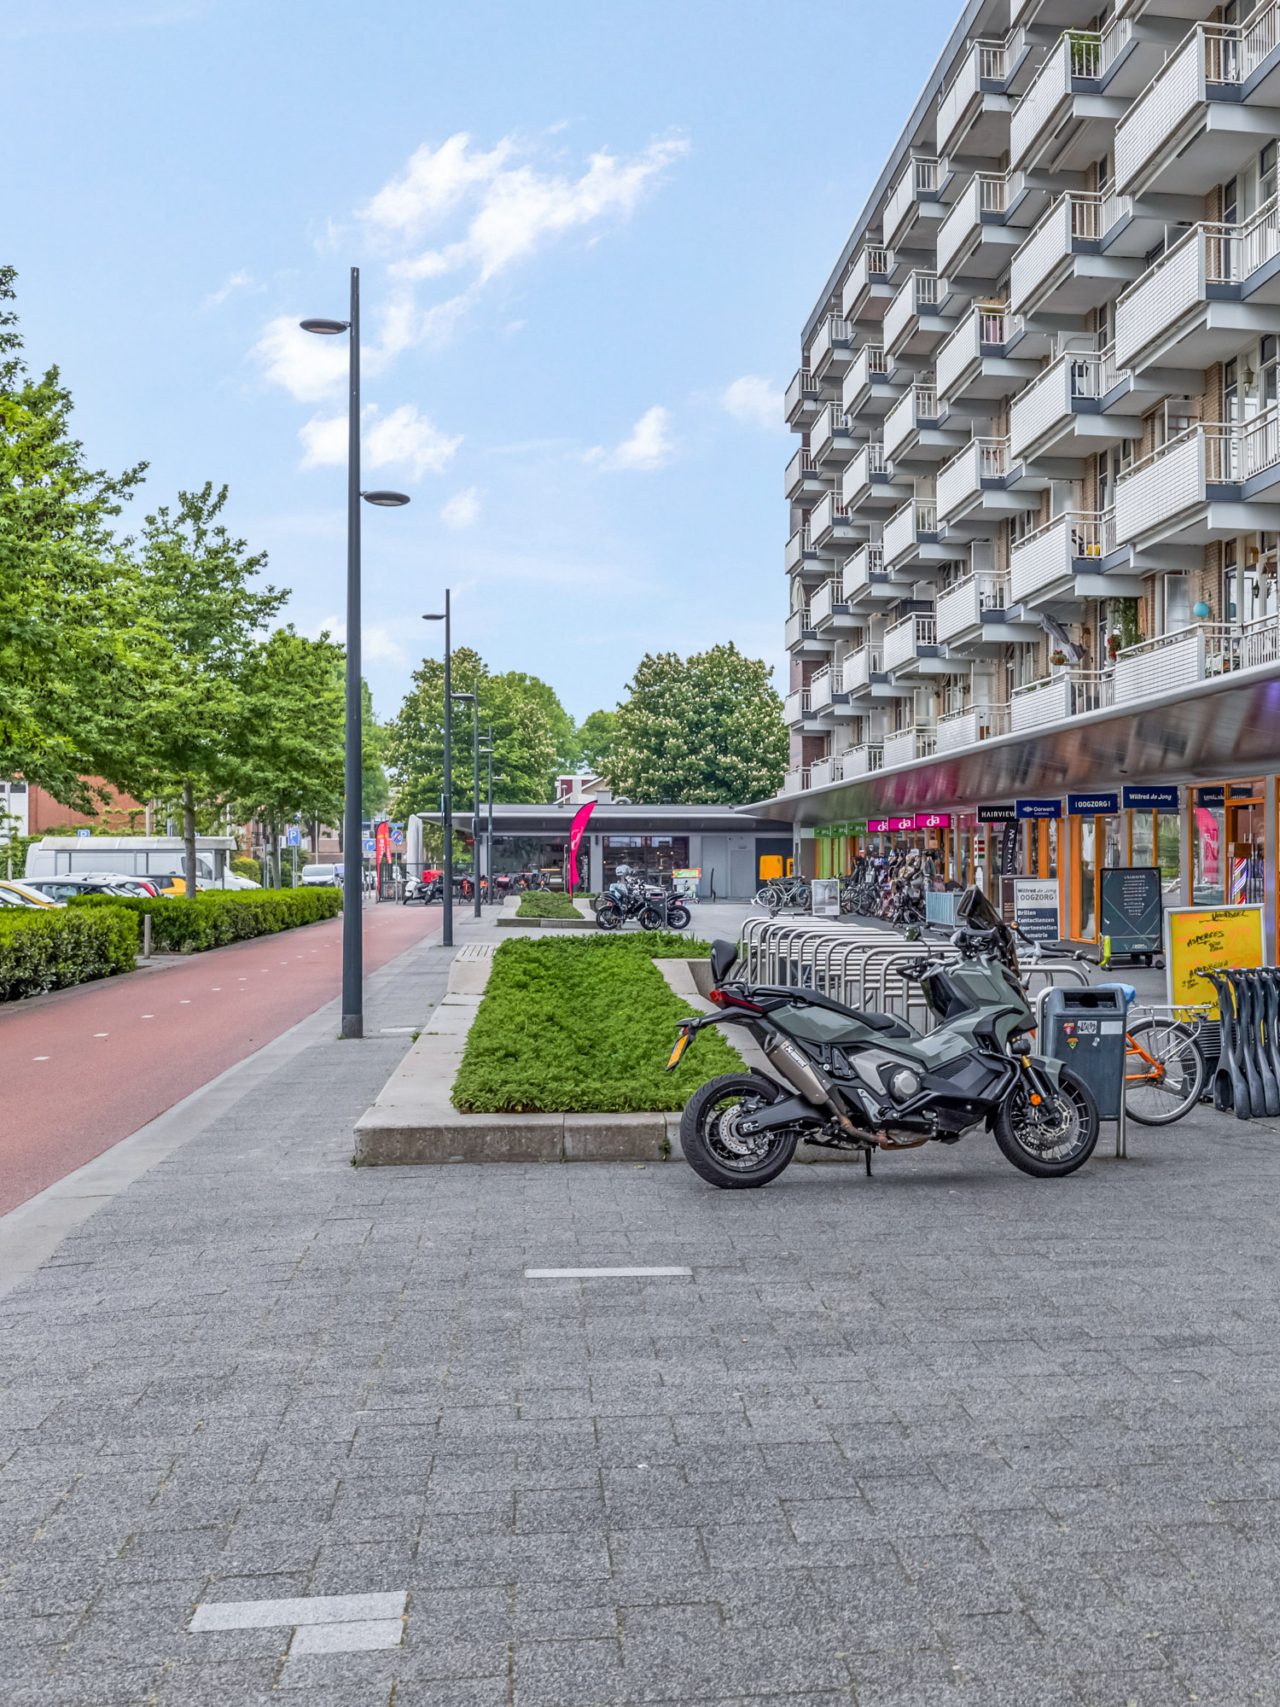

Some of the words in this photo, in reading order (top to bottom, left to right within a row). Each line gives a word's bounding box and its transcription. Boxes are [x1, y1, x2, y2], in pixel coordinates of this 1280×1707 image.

[981, 810, 1015, 818] HAIRVIEW
[898, 818, 912, 829] da
[926, 815, 940, 826] da
